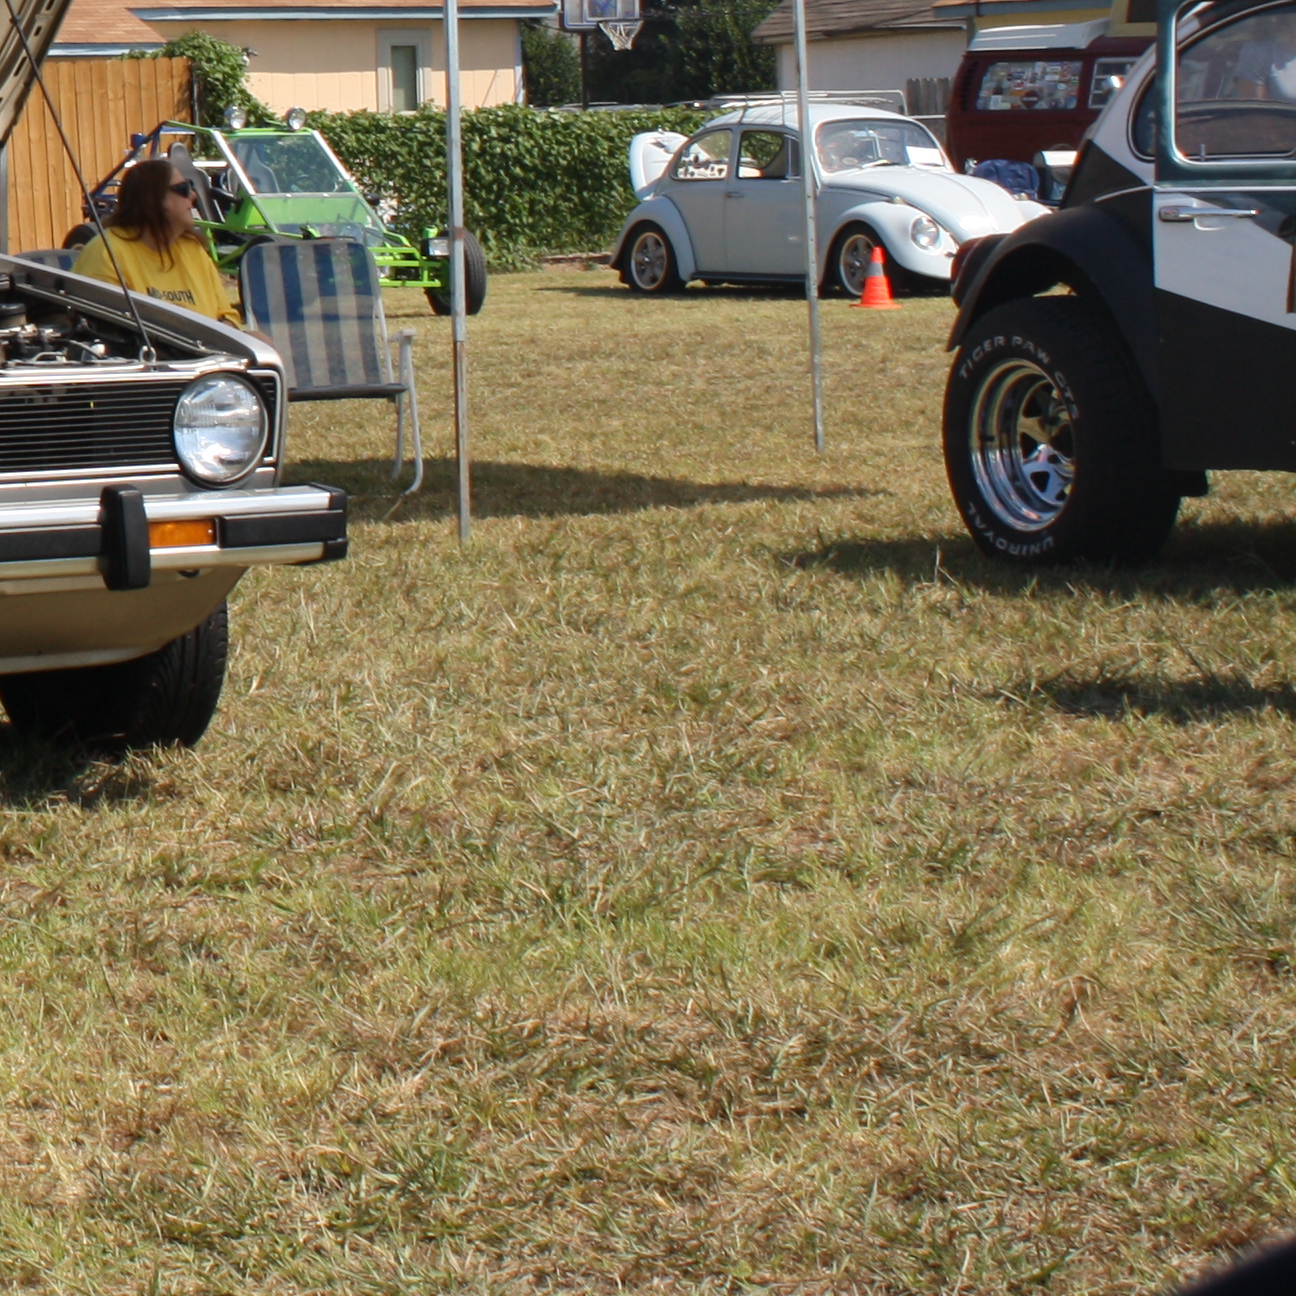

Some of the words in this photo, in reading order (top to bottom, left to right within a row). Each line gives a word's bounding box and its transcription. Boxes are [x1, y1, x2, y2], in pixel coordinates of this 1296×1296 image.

[958, 335, 1006, 379] TIGER
[1011, 335, 1051, 365] PAW
[967, 501, 1055, 556] UNIROYAL
